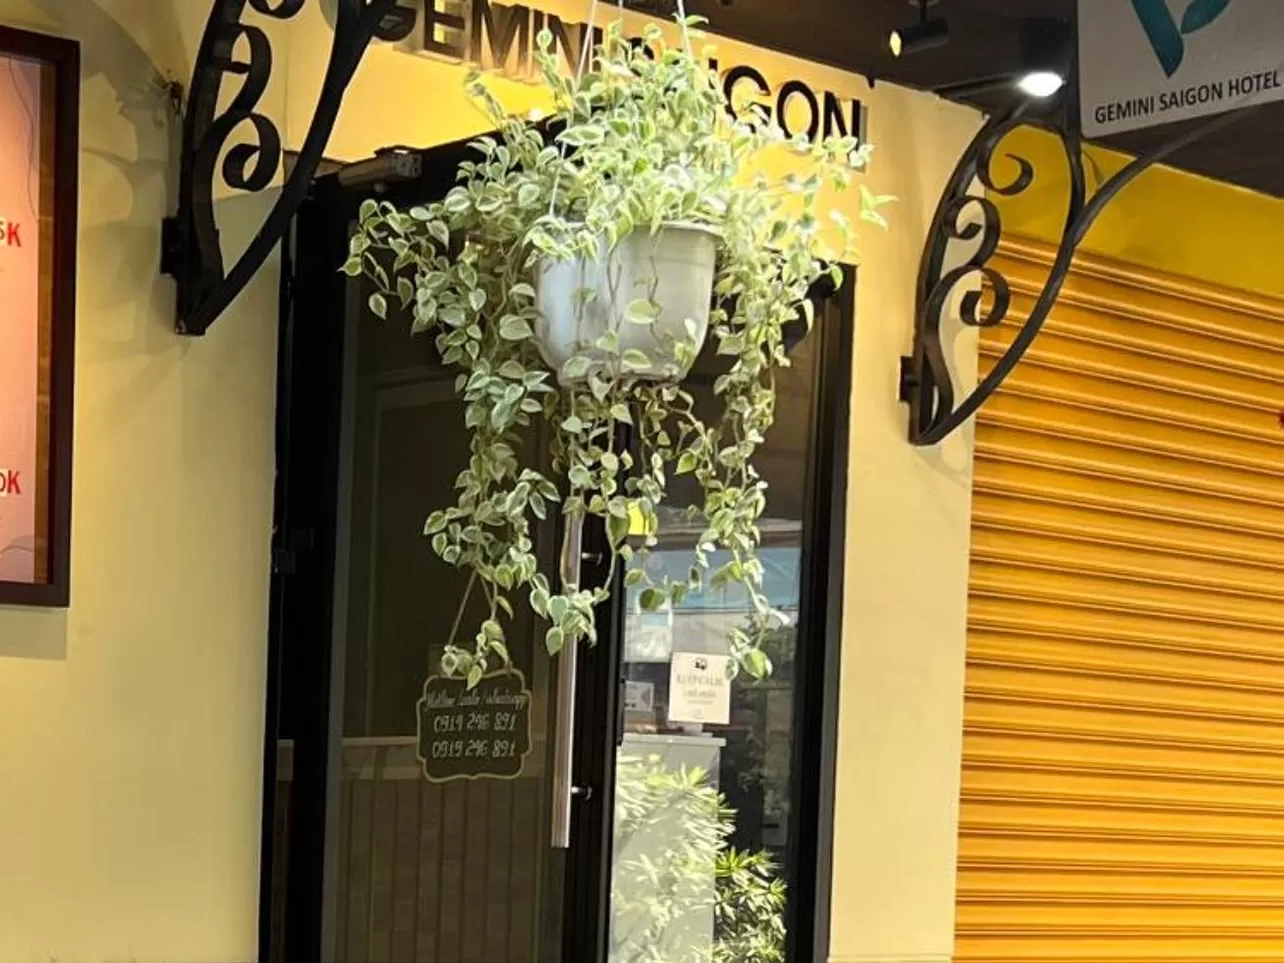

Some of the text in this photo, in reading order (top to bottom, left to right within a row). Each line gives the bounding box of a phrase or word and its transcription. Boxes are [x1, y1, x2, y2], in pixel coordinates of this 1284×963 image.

[1094, 70, 1281, 124] GEMINI SAIGON HOTEL
[492, 739, 517, 758] 891
